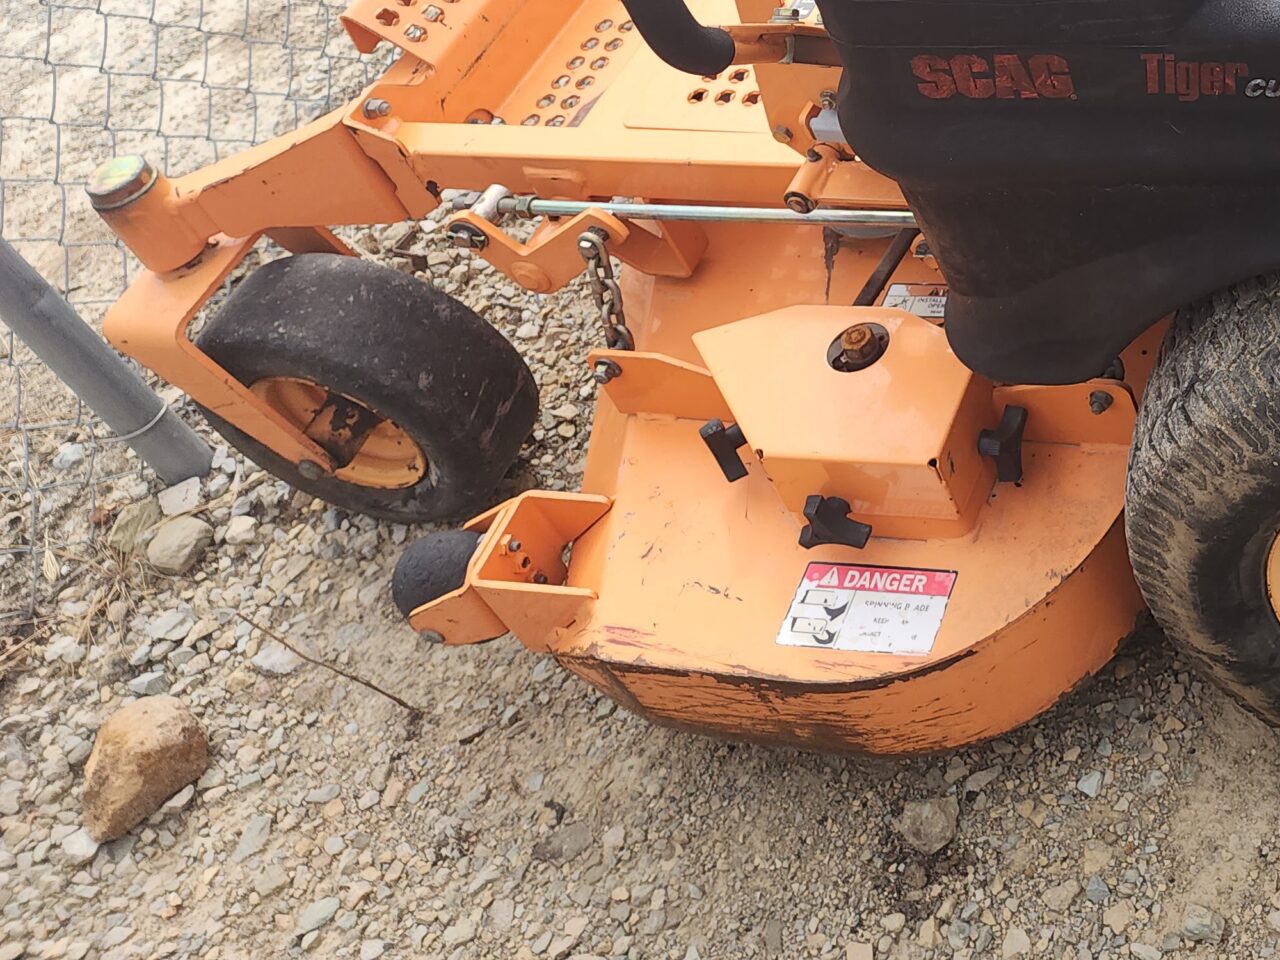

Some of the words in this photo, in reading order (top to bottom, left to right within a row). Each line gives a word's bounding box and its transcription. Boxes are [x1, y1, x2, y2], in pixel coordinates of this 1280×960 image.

[909, 53, 1070, 100] SCAG
[1140, 52, 1248, 102] Tiger
[843, 570, 927, 593] DANGER
